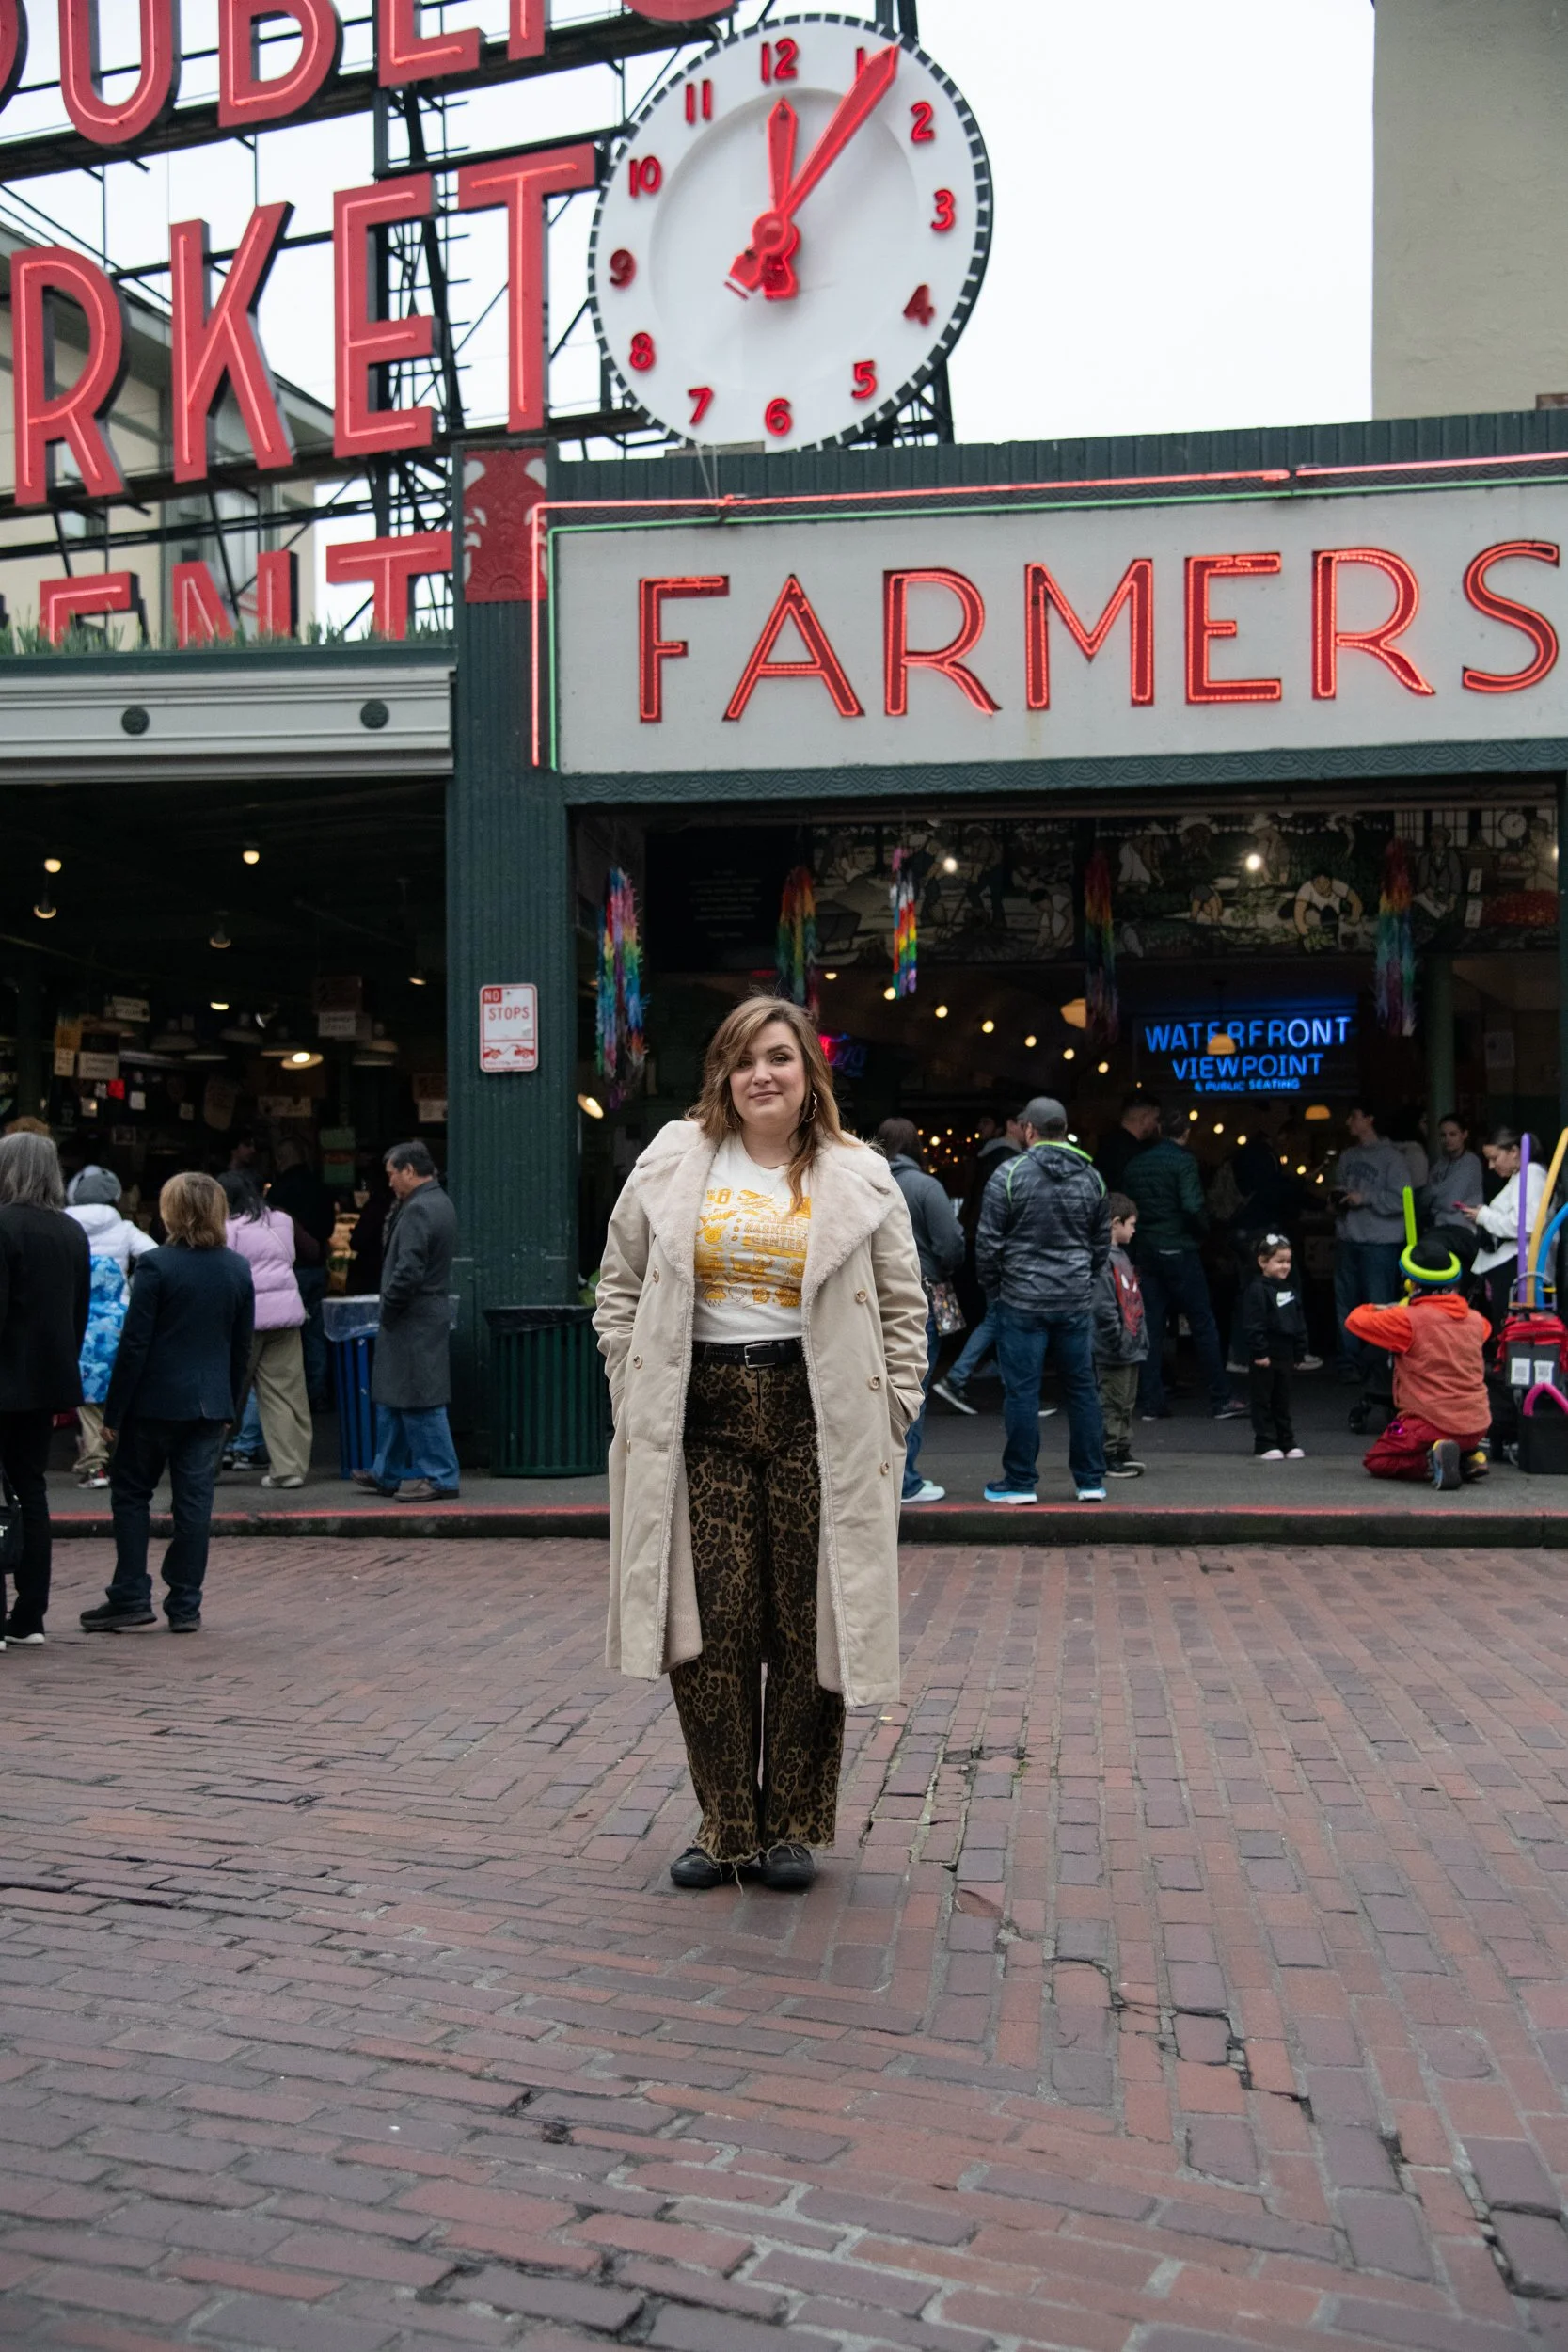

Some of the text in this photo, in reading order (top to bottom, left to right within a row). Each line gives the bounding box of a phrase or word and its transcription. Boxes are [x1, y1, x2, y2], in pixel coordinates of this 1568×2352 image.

[760, 38, 800, 84] 12
[684, 79, 713, 124] 11
[910, 102, 936, 144] 2
[628, 155, 662, 198] 10
[929, 189, 957, 233] 3
[609, 248, 637, 289] 9
[903, 284, 935, 326] 4
[628, 332, 656, 372] 8
[850, 360, 879, 400] 5
[688, 386, 714, 425] 7
[764, 398, 792, 437] 6
[638, 540, 1561, 723] FARMERS
[483, 989, 500, 1002] NO
[488, 1006, 531, 1022] STOPS
[1172, 1053, 1324, 1081] VIEWPOINT
[1205, 1080, 1245, 1092] PUBLIC
[1249, 1077, 1300, 1091] SEATING
[751, 1235, 806, 1251] CENTER
